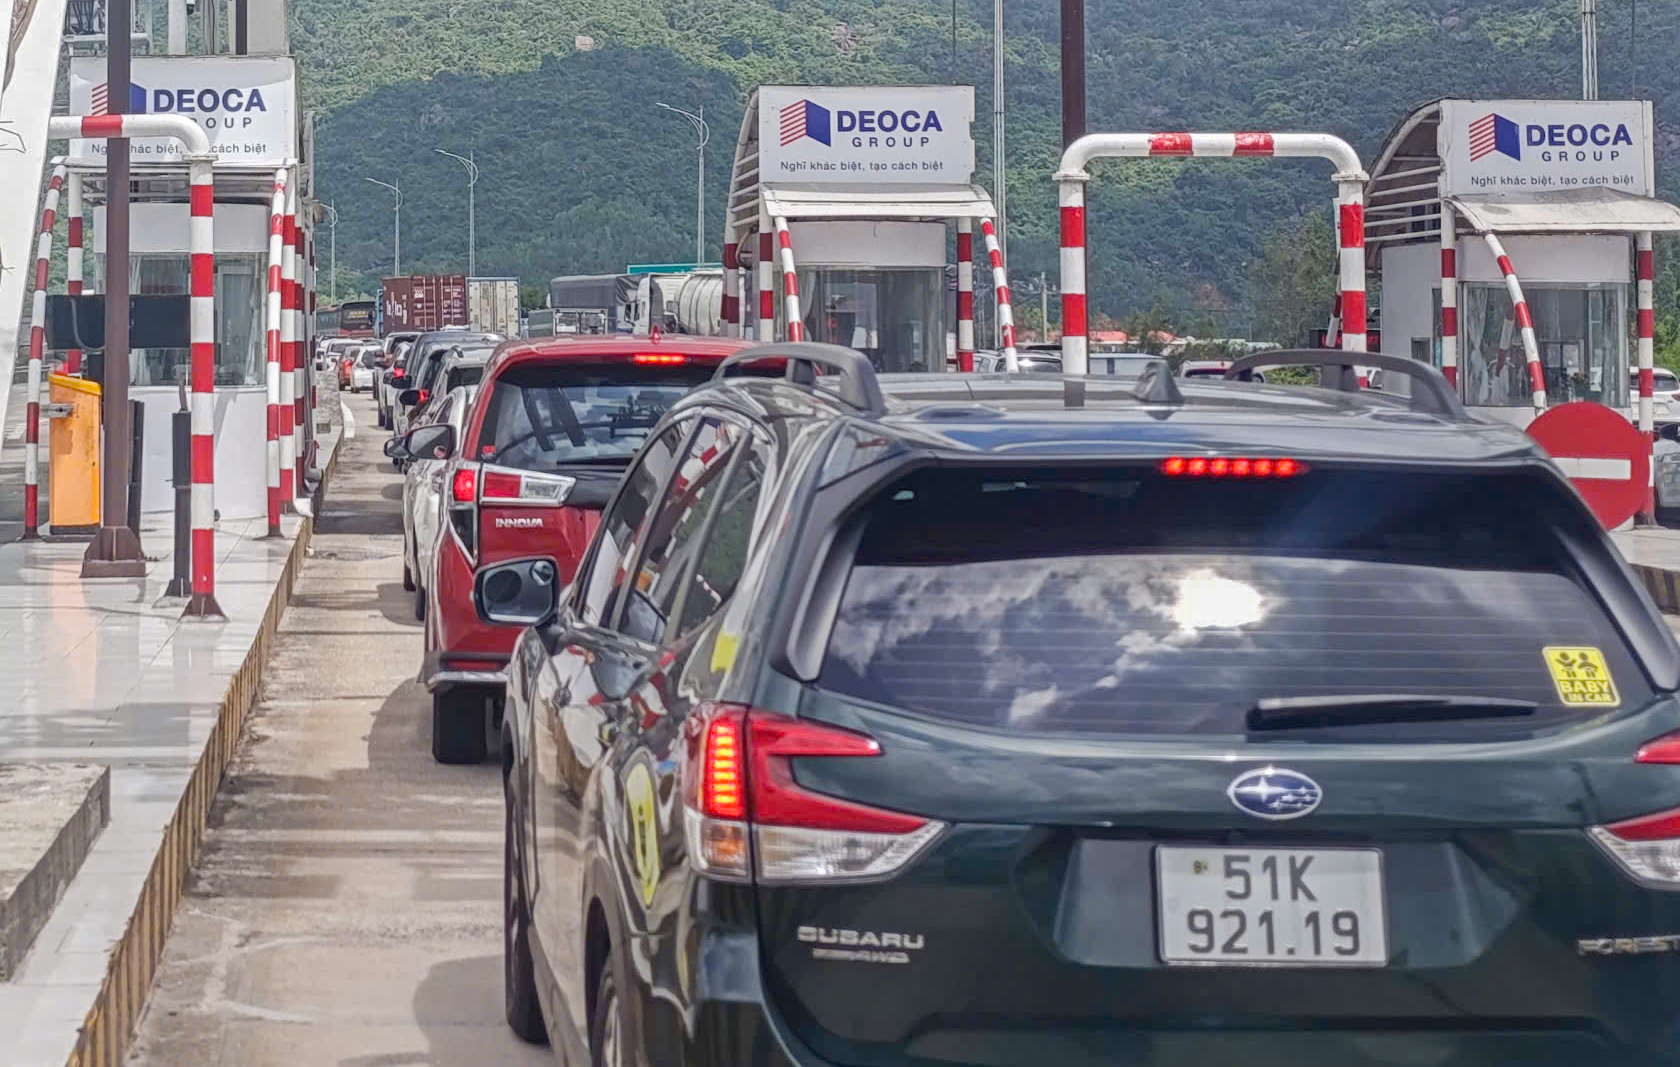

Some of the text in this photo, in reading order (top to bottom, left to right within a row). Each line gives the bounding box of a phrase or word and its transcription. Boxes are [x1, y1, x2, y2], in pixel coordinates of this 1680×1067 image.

[154, 88, 267, 113] DEOCA
[192, 117, 253, 129] OUP
[837, 110, 943, 132] DEOCA
[1526, 124, 1633, 146] DEOCA
[852, 136, 930, 148] GROUP
[131, 143, 152, 154] hác
[211, 143, 240, 154] cách
[244, 143, 267, 155] biệt
[1541, 150, 1620, 162] GROUP
[810, 161, 836, 171] khác
[840, 161, 865, 172] biệt,
[869, 163, 888, 172] tạo
[891, 161, 918, 171] cách
[922, 161, 944, 172] biệt
[1500, 175, 1527, 186] khác
[1530, 175, 1556, 187] biệt,
[1560, 177, 1578, 187] tạo
[1582, 175, 1609, 185] cách
[1613, 174, 1634, 186] biệt
[495, 517, 544, 528] INNOVA
[1560, 680, 1609, 693] BABY
[1223, 854, 1318, 901] 51K
[797, 925, 925, 949] SUBARU
[1187, 907, 1361, 956] 921.19
